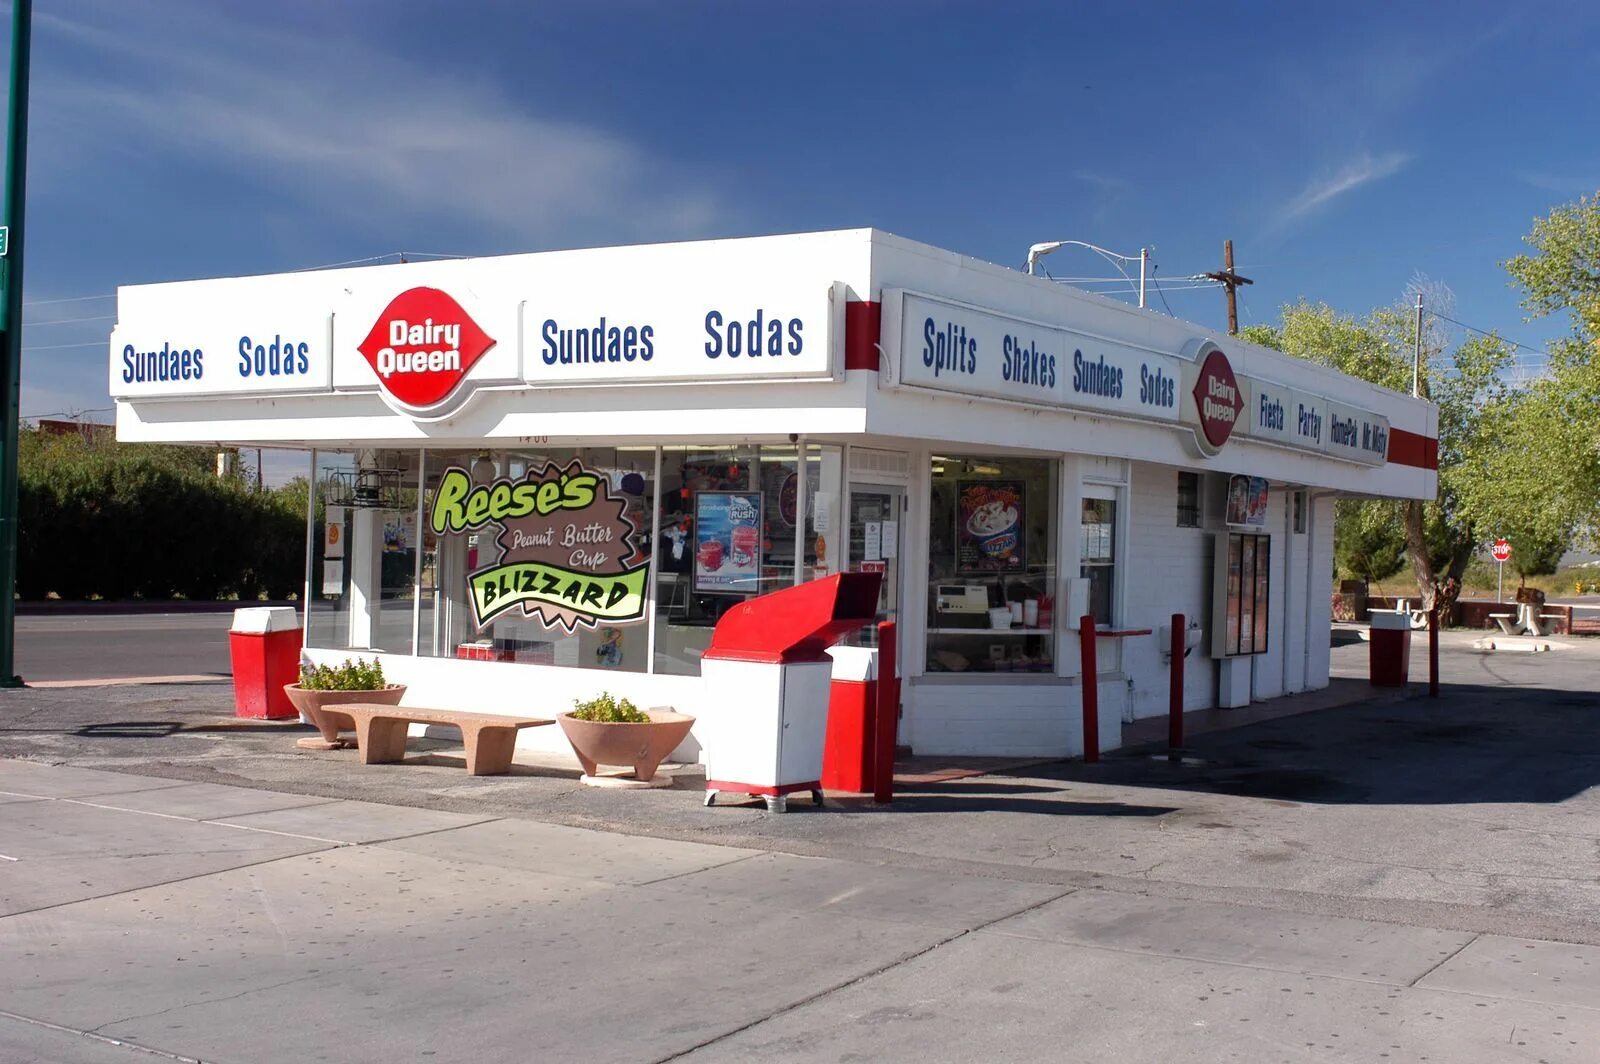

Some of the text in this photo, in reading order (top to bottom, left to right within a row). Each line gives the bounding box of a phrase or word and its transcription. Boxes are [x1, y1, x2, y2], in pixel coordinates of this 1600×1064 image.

[389, 317, 462, 350] Dairy
[542, 308, 804, 366] Sundaes Sodas
[122, 334, 310, 384] Sundaes Sodas
[376, 346, 461, 380] Queen
[922, 316, 1175, 409] Splits Shakes Sundaes Sodas
[1207, 374, 1236, 402] Dairy
[1203, 396, 1236, 423] Queen
[1260, 393, 1284, 432] Fiesta
[1298, 404, 1322, 445] Parfay
[1371, 424, 1388, 459] Misty
[431, 471, 599, 534] Reese's
[511, 522, 614, 550] Peanut Butter
[568, 548, 609, 571] Cup
[483, 570, 629, 610] BLIZZARD
